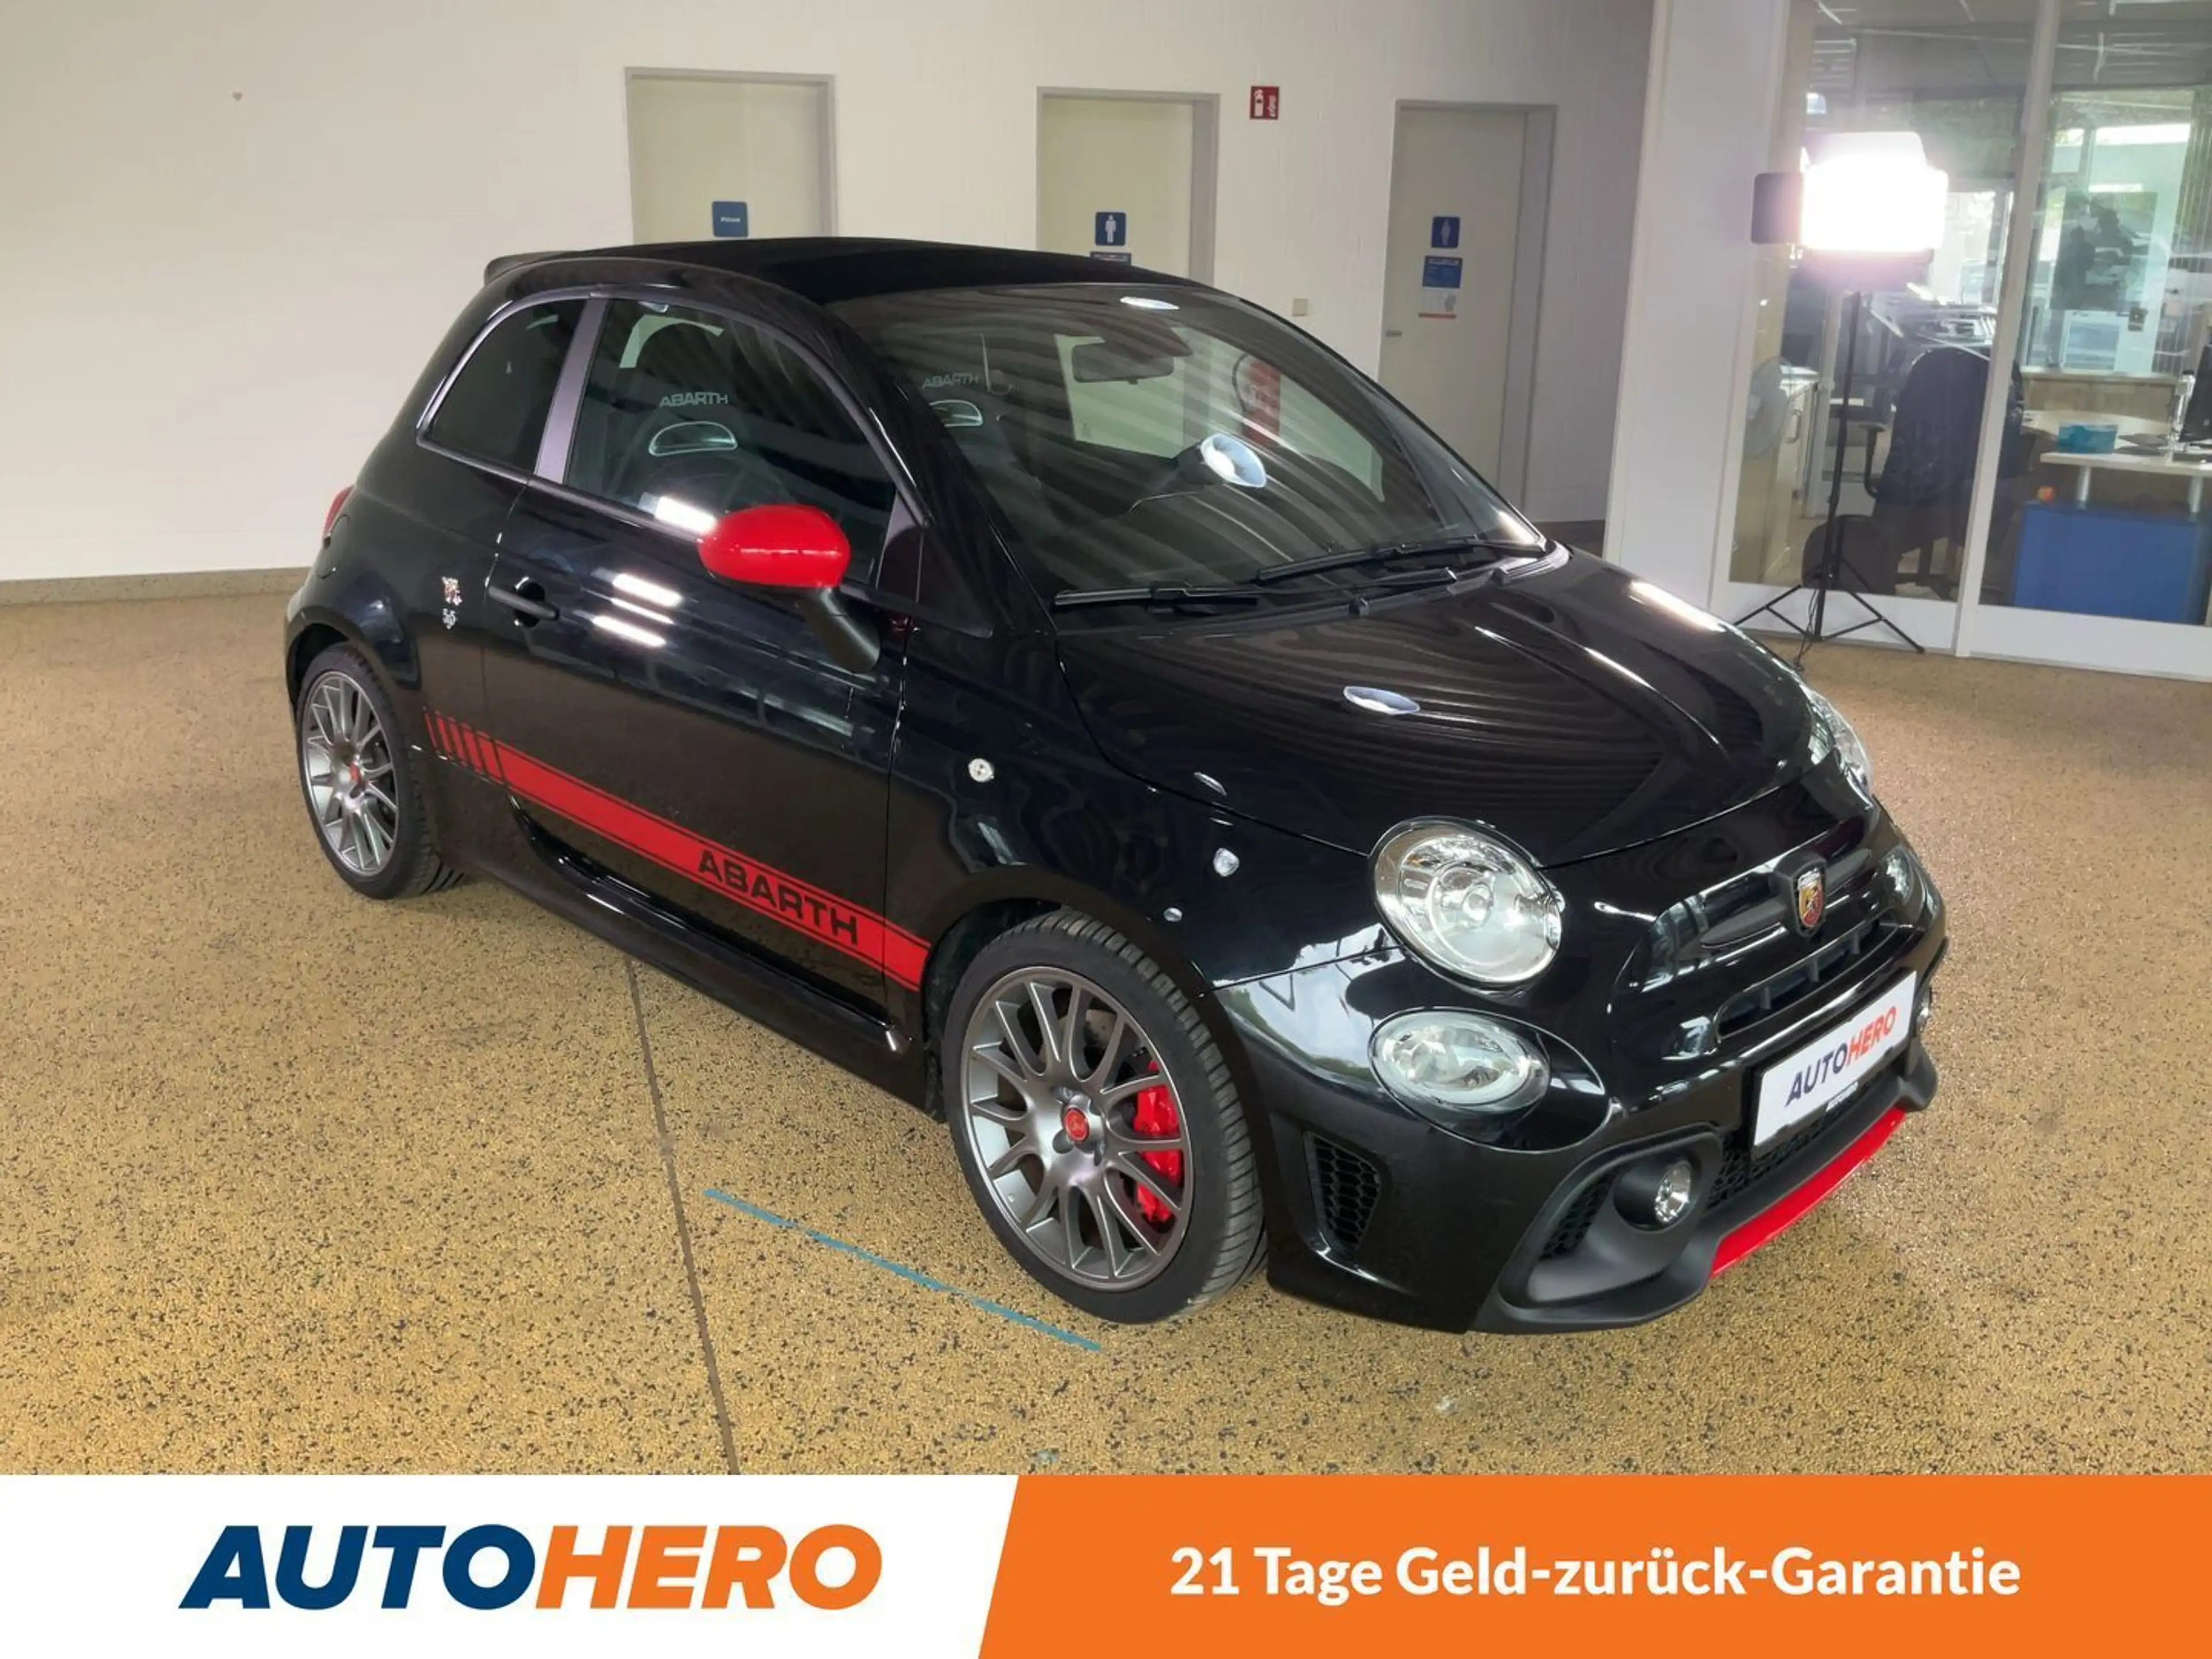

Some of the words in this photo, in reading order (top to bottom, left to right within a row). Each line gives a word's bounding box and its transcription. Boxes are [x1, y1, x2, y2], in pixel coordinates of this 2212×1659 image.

[659, 392, 728, 407] ABARTH
[699, 849, 858, 944] ABARTH
[1785, 1006, 1897, 1107] AUTOHERO
